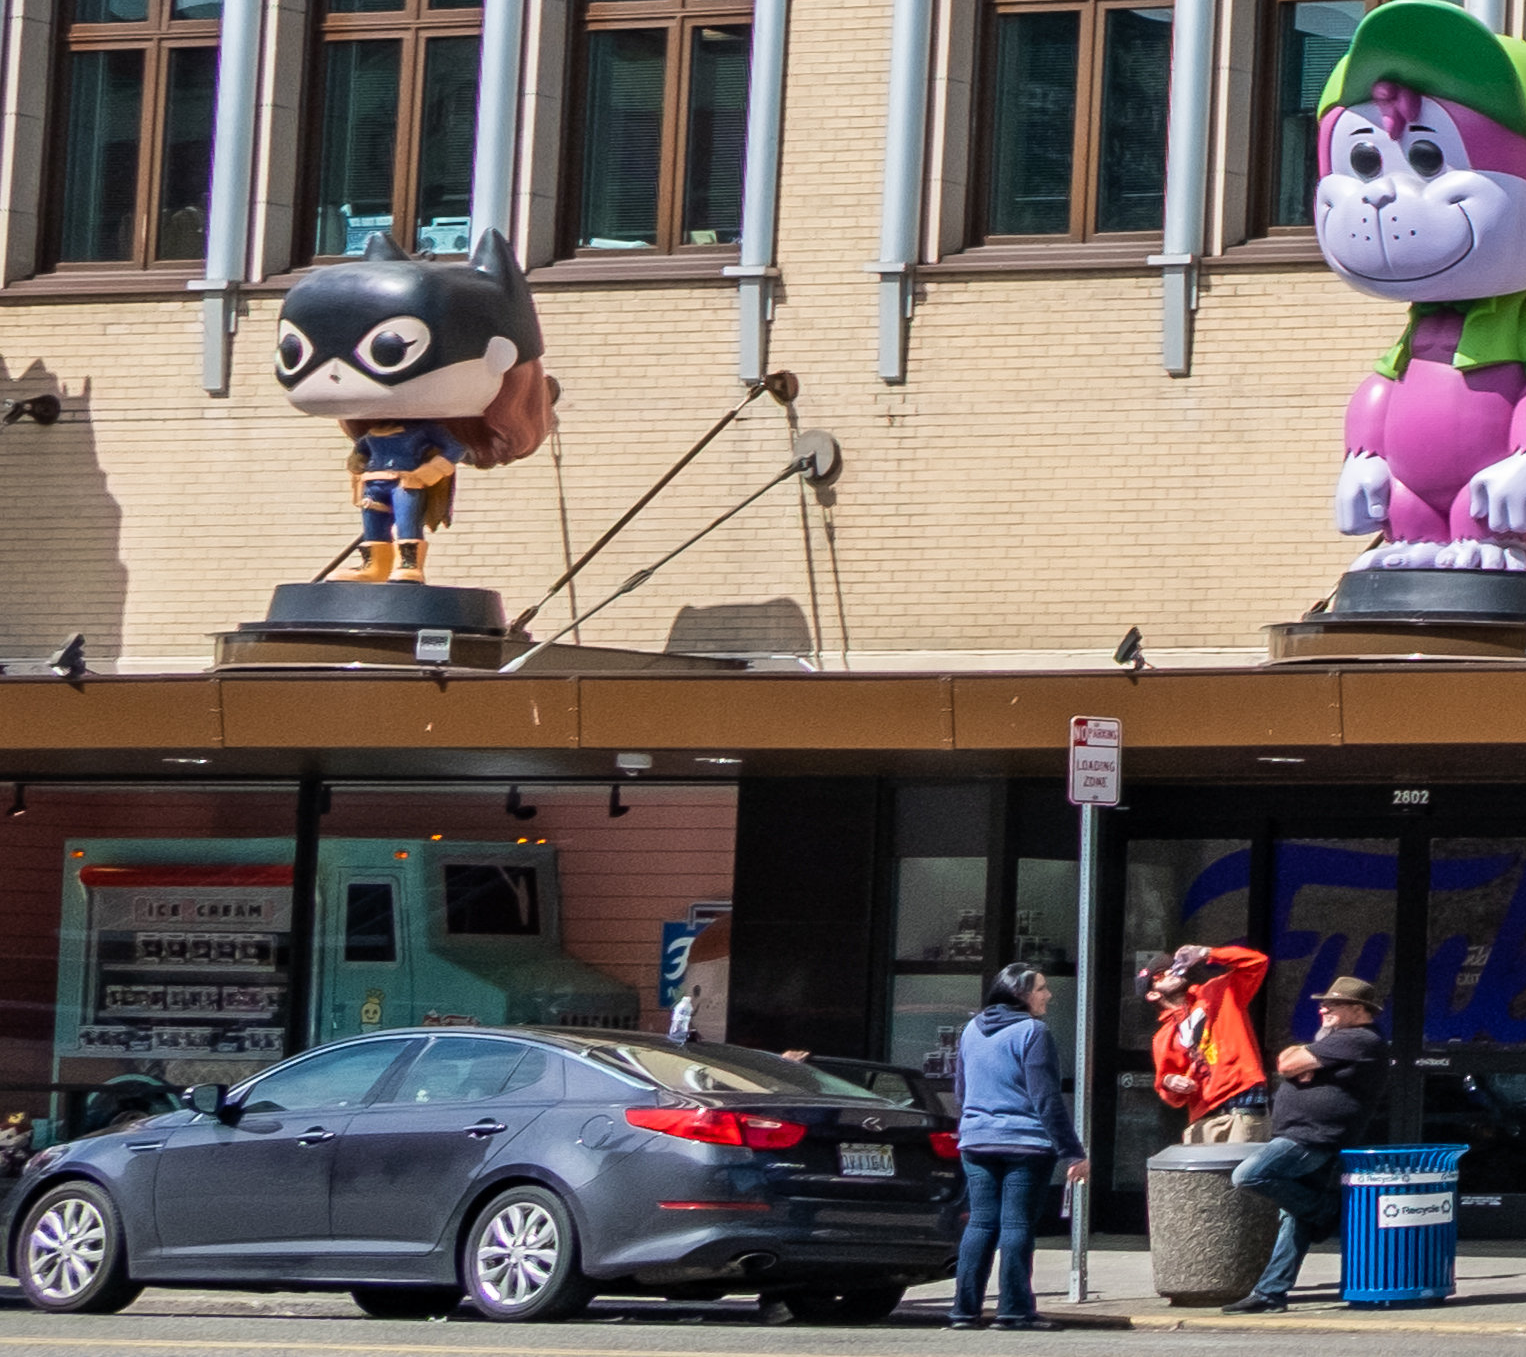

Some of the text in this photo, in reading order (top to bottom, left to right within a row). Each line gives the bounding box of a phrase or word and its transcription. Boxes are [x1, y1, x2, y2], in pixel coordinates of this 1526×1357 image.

[1074, 726, 1117, 741] NO PARKING
[1076, 760, 1116, 772] LOADING
[1083, 776, 1108, 788] ZONE
[1392, 790, 1429, 804] 2802
[148, 903, 263, 917] ICE CREAM
[1402, 1204, 1440, 1216] Recycle
